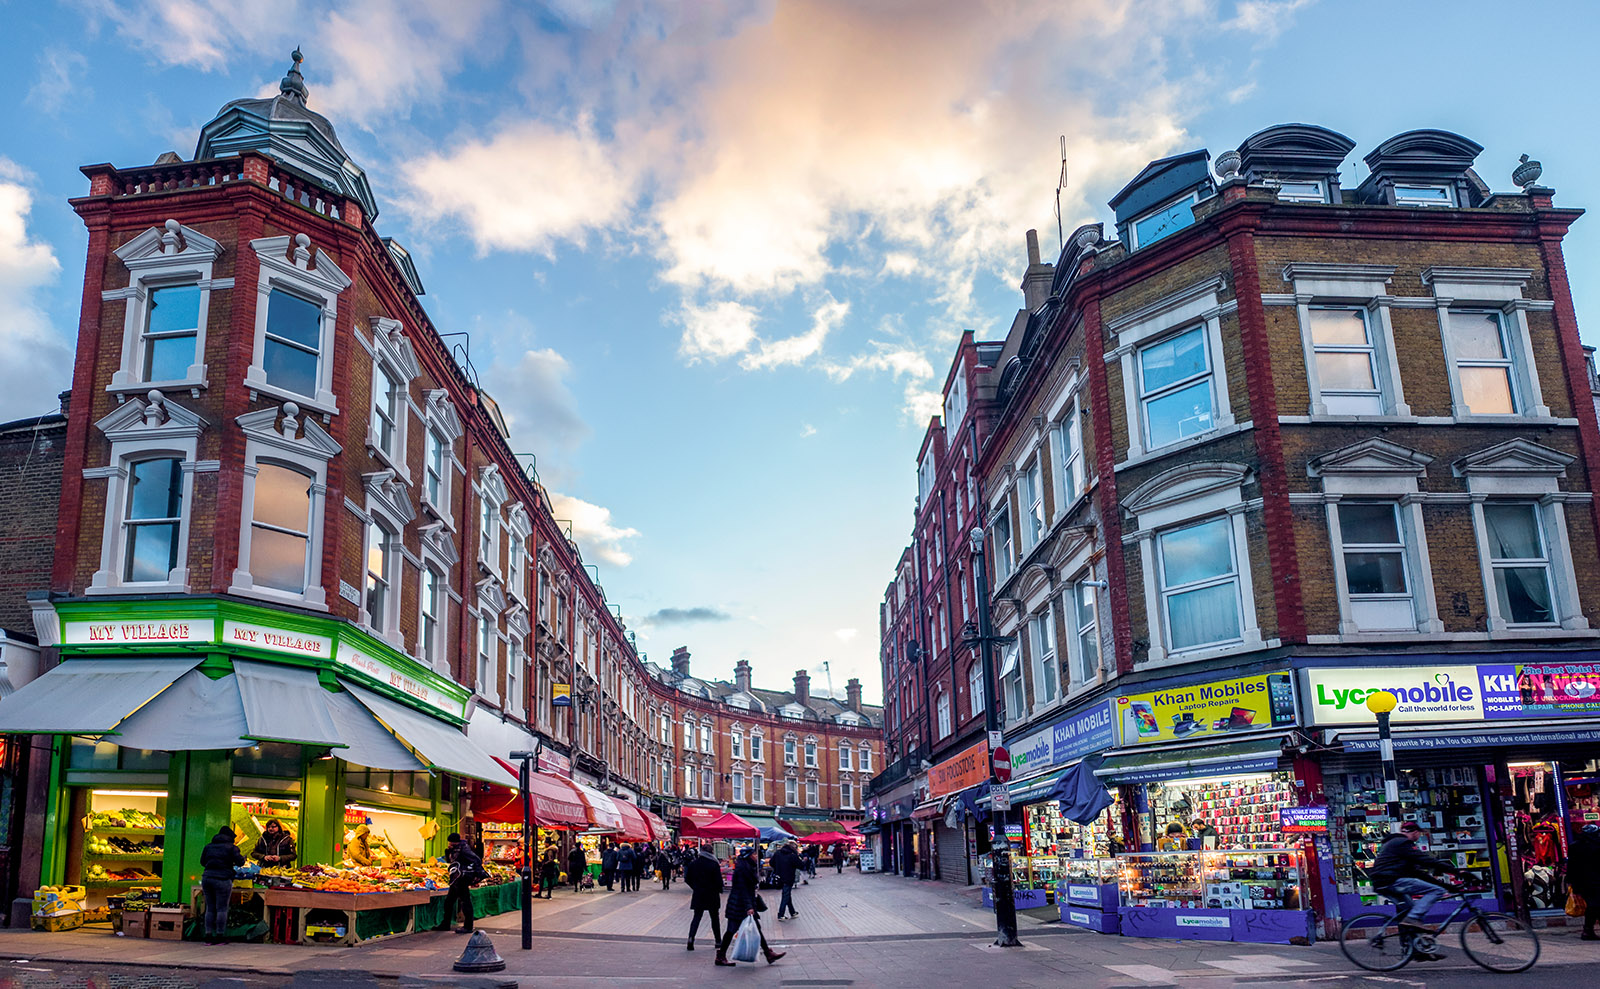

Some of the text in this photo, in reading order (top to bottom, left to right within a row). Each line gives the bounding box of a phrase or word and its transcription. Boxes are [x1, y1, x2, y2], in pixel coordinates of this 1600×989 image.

[89, 623, 190, 640] MY VILLAGE
[233, 628, 322, 652] MY VILLAGE
[1522, 665, 1542, 675] The
[1543, 665, 1565, 675] Best
[1564, 664, 1593, 674] Waist
[389, 671, 429, 701] MY VILLAGE
[1154, 681, 1266, 707] Khan Mobiles
[1179, 697, 1240, 712] Laptop Repairs
[1398, 705, 1413, 713] Call
[1414, 705, 1426, 713] the
[1426, 704, 1448, 712] world
[1488, 704, 1527, 712] PC-LAPTOP
[1054, 708, 1110, 744] KHAN MOBILE
[1350, 741, 1365, 749] The
[1419, 738, 1434, 748] Pay
[1435, 737, 1446, 746] As
[1446, 737, 1460, 745] You
[1461, 736, 1472, 745] Go
[1472, 735, 1488, 744] SIM
[1488, 735, 1499, 743] for
[1499, 735, 1513, 743] low
[1514, 734, 1530, 742] cost
[1530, 731, 1576, 742] International
[1577, 731, 1591, 739] and
[1011, 741, 1050, 769] Lycamobile
[1182, 917, 1224, 926] Lycamobile
